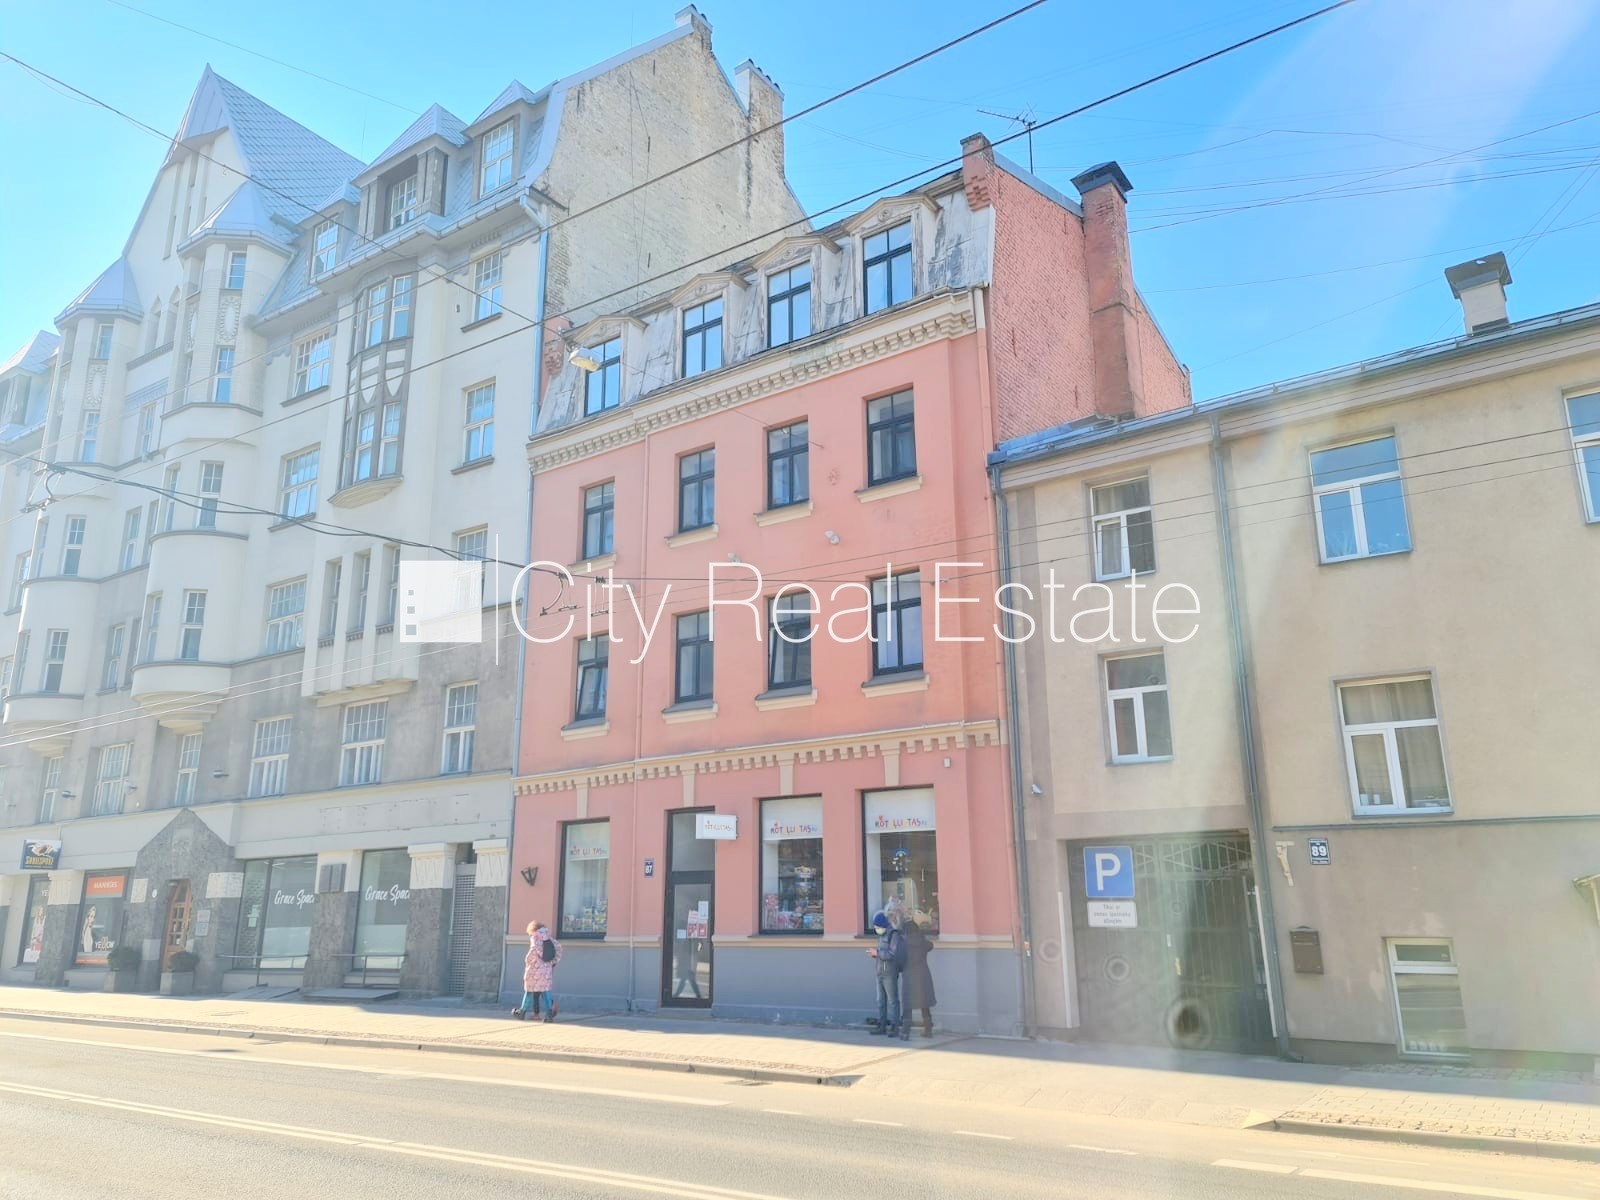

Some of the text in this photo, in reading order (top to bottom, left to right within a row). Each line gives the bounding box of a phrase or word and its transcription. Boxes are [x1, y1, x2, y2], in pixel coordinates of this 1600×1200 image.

[1311, 845, 1327, 857] 89
[645, 865, 653, 874] 87
[1095, 853, 1121, 891] P
[274, 890, 295, 904] Grace
[365, 885, 388, 901] Grace
